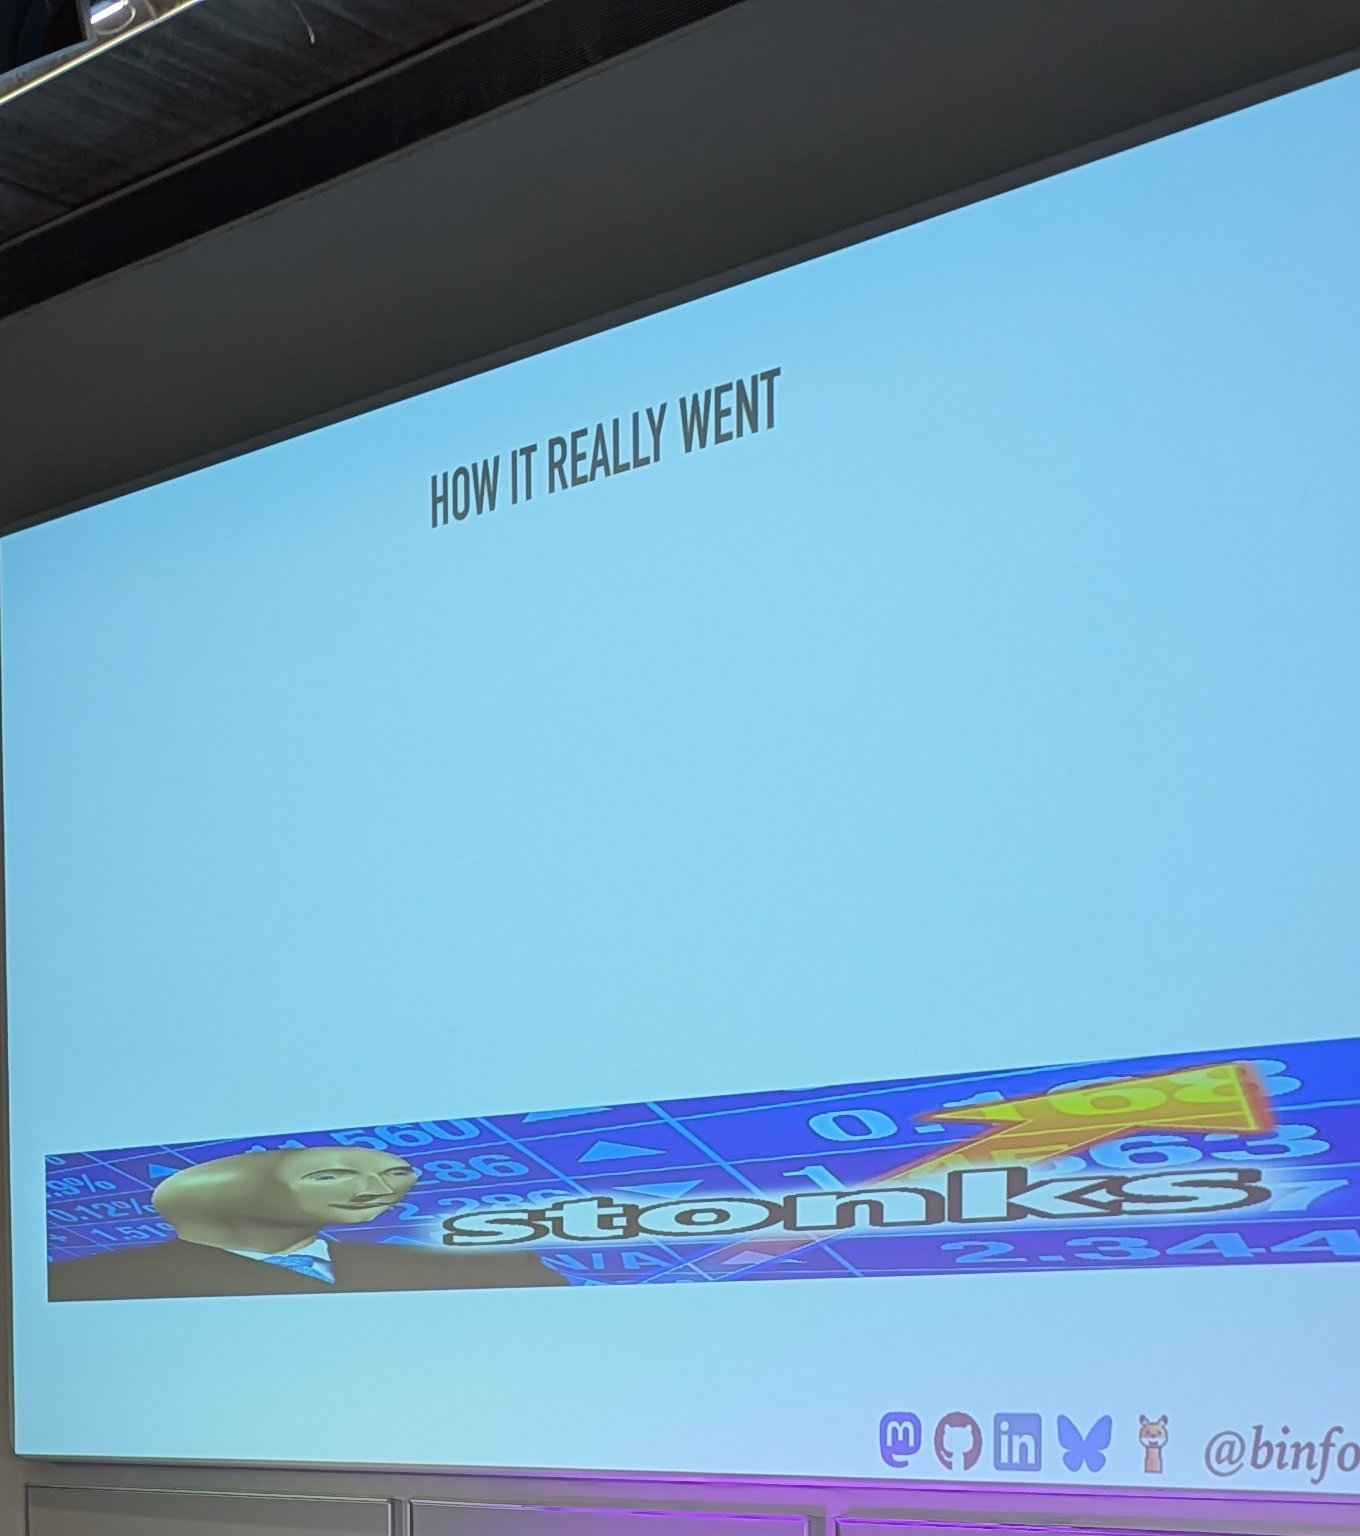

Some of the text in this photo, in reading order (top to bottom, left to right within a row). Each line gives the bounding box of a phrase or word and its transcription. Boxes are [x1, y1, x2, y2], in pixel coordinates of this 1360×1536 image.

[431, 366, 782, 529] HOW IT REALLY WENT
[443, 1166, 1272, 1246] stonks
